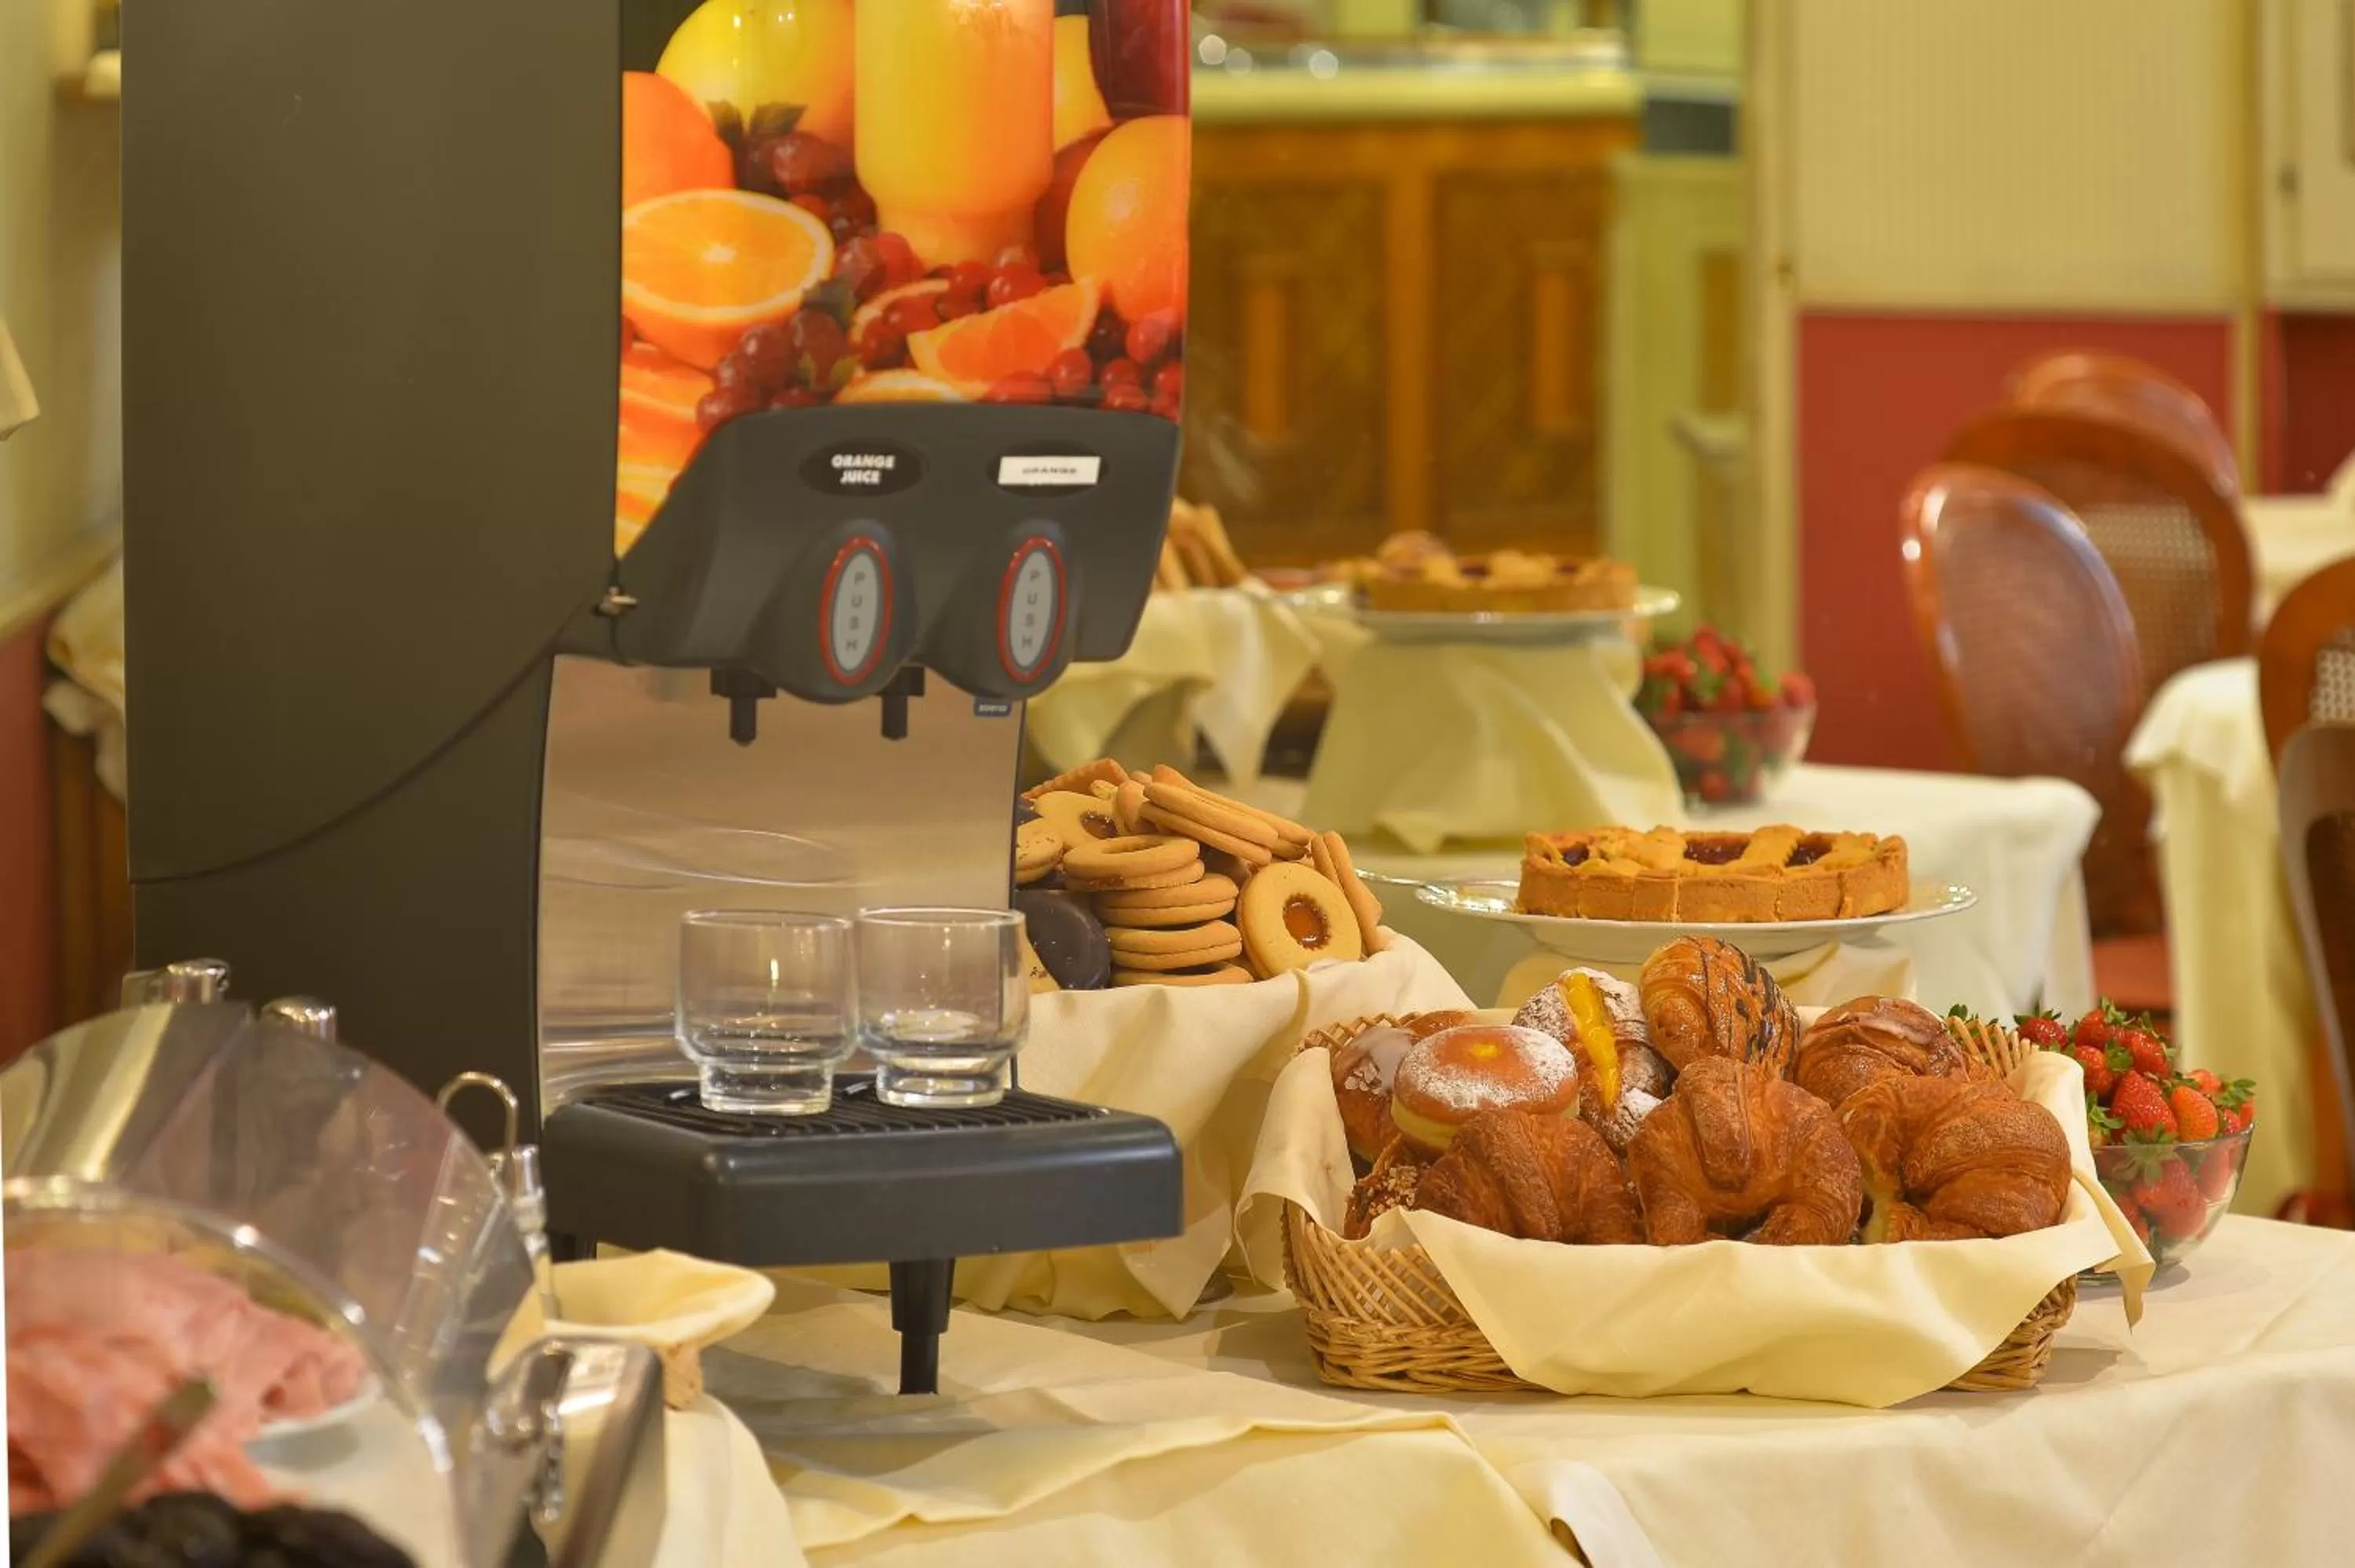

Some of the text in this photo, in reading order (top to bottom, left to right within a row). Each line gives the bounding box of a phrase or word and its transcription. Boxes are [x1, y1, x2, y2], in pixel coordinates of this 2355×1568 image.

[831, 454, 896, 470] ORANGE
[839, 470, 880, 484] JUICE
[845, 571, 866, 651] PUSH
[1022, 569, 1040, 648] PUSH
